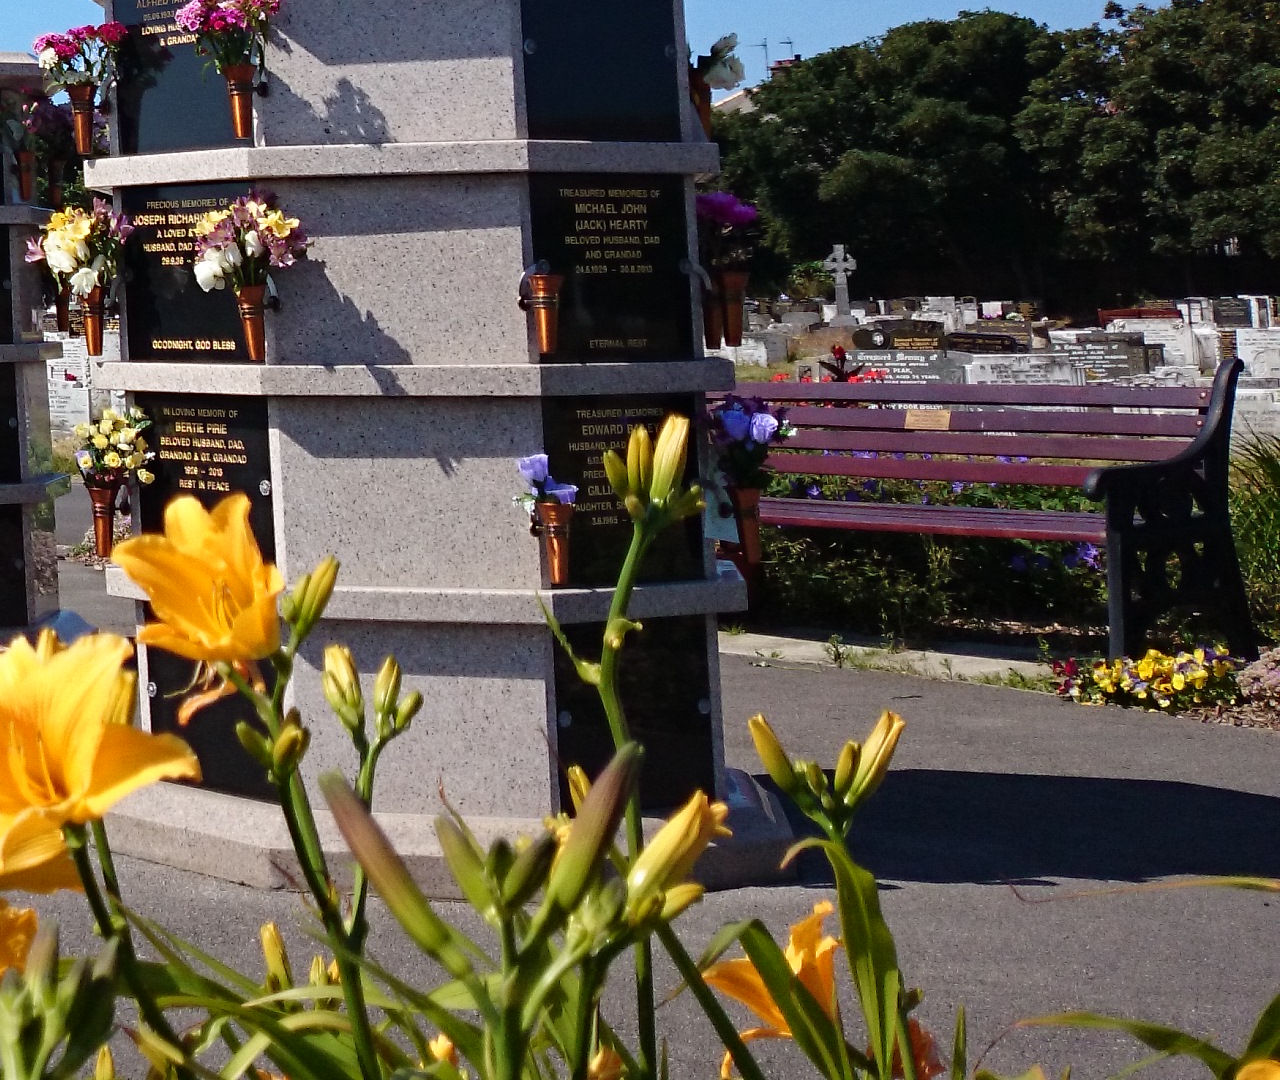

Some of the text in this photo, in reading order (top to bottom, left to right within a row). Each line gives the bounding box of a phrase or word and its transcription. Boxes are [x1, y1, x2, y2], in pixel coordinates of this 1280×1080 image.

[141, 24, 166, 35] LOVING
[560, 189, 660, 198] TREASURED MEMORIES OF
[147, 201, 179, 209] PRECIOUS
[182, 199, 217, 208] MEMORIES
[575, 204, 646, 214] MICHAEL JOHN
[133, 215, 166, 226] JOSEPH
[576, 220, 647, 231] (JACK) HEARTY
[157, 230, 162, 238] A
[164, 229, 186, 238] LOVED
[565, 236, 600, 244] BELOVED
[143, 243, 176, 252] HUSBAND,
[178, 243, 192, 251] DAD
[586, 251, 642, 259] AND GRANDAD
[195, 340, 211, 349] GOD
[213, 341, 236, 350] BLESS
[590, 339, 648, 348] ETERNAL REST
[858, 352, 891, 360] Treasured
[896, 353, 925, 362] Memory
[163, 408, 238, 418] IN LOVING MEMORY OF
[576, 408, 664, 419] TREASURED MEMORIES
[175, 422, 227, 434] BERTIE PIRIE
[582, 424, 623, 436] EDWARD
[160, 437, 245, 450] BELOVED HUSBAND, DAD,
[569, 442, 606, 451] HUSBAND,
[160, 450, 192, 460] GRANDAD
[194, 452, 199, 461] &
[213, 453, 247, 464] GRANDAD
[179, 479, 230, 491] REST IN PEACE
[588, 486, 613, 496] GILLI
[575, 502, 613, 511] AUGHTER,
